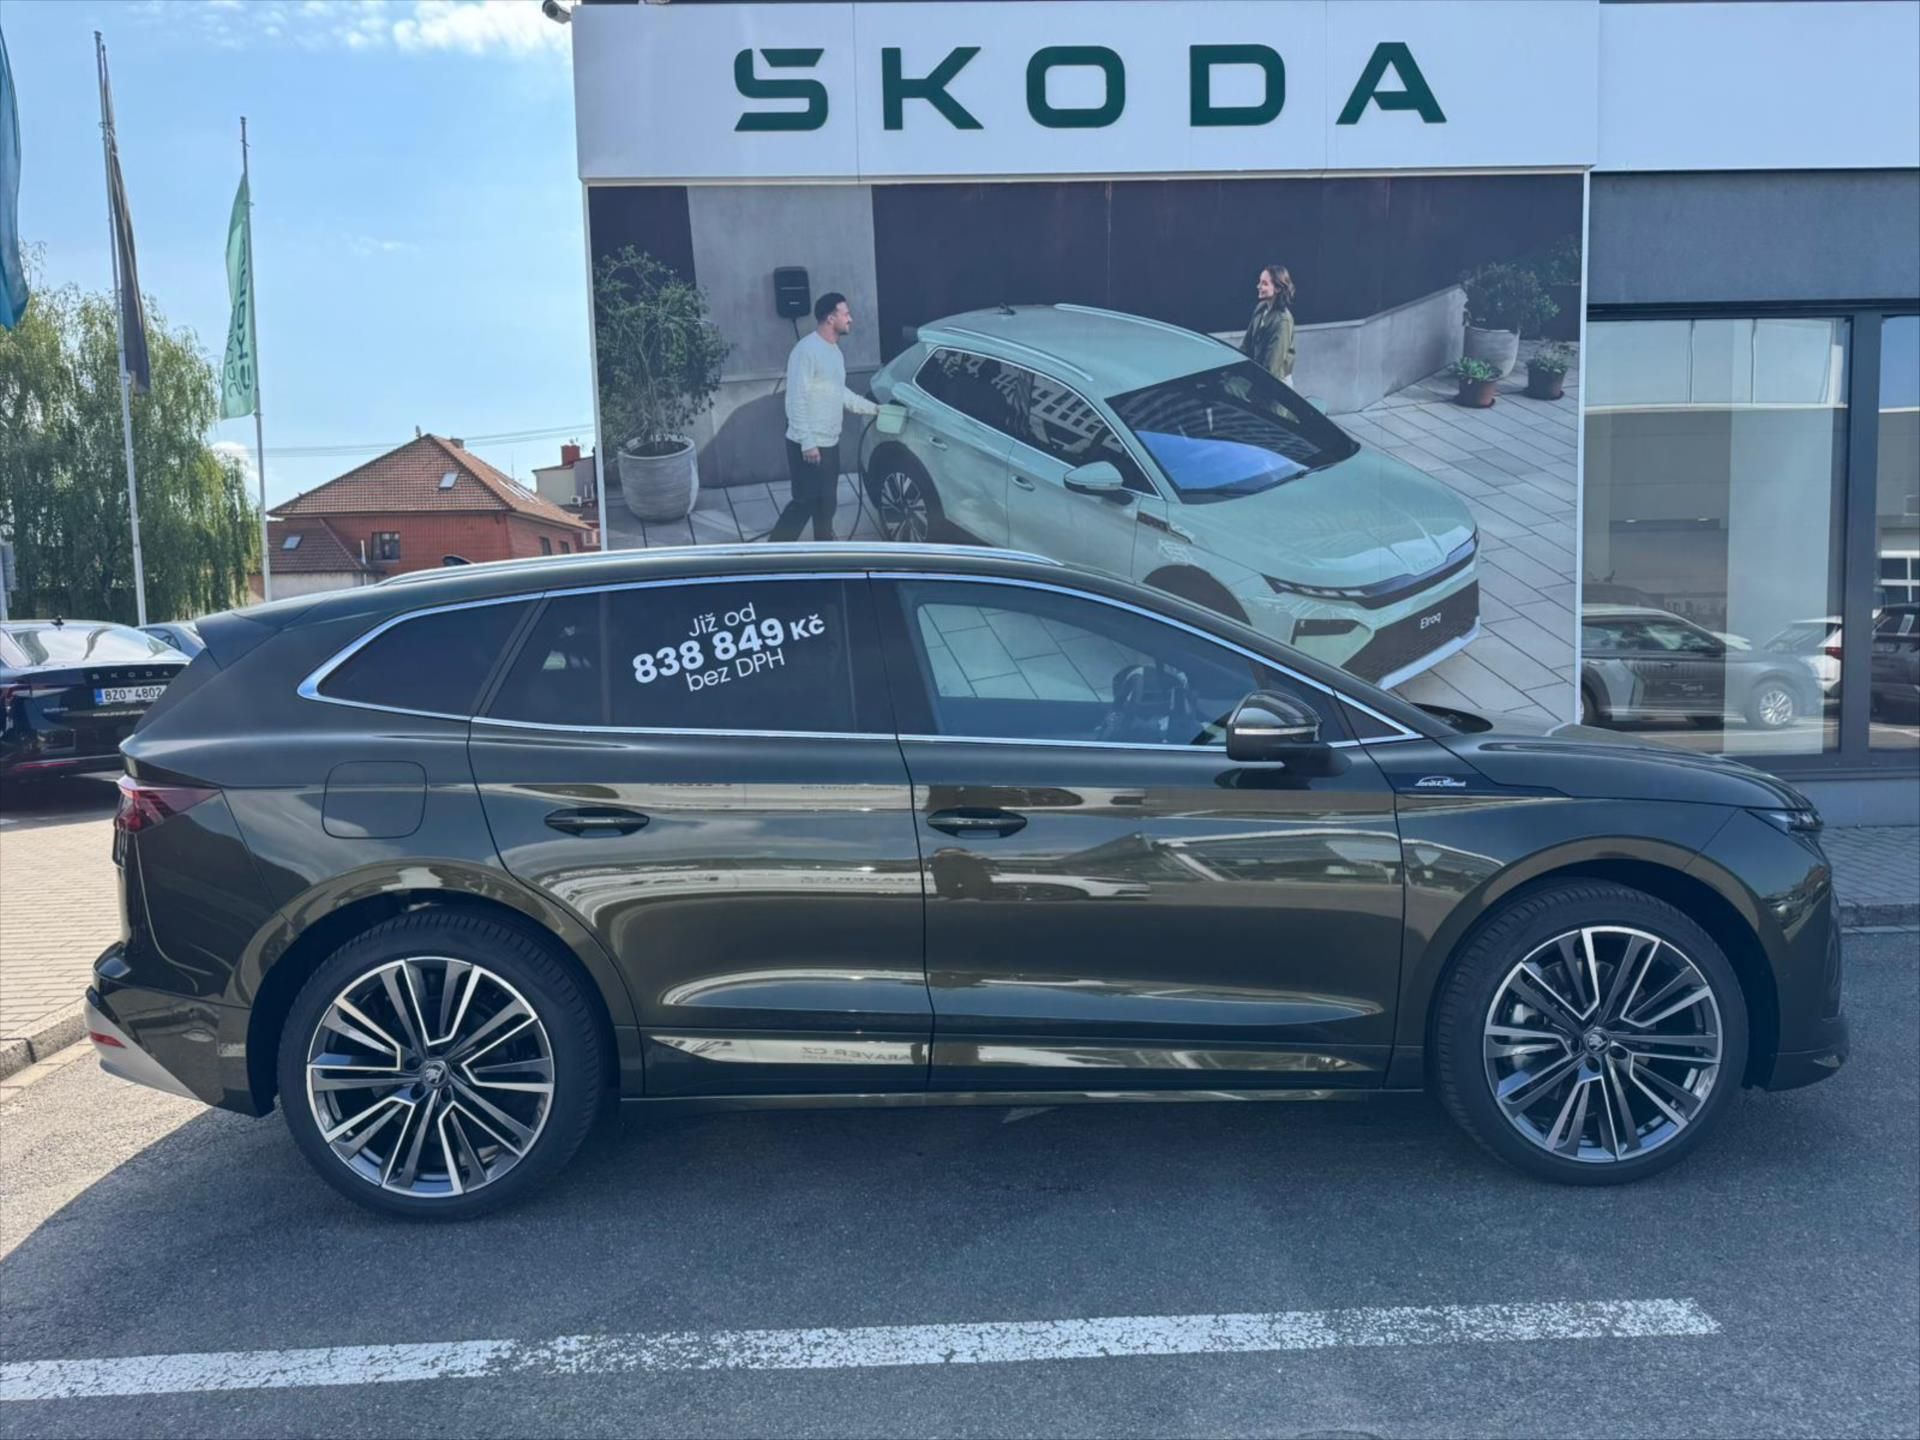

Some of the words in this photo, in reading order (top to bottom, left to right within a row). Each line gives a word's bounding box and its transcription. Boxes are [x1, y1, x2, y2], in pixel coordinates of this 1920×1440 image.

[689, 612, 719, 637] Již
[724, 602, 756, 627] od
[1420, 612, 1442, 630] Elroq
[632, 640, 704, 683] 838
[712, 618, 784, 661] 849
[790, 614, 825, 640] Kč
[686, 667, 731, 692] bez
[736, 648, 785, 677] DPH
